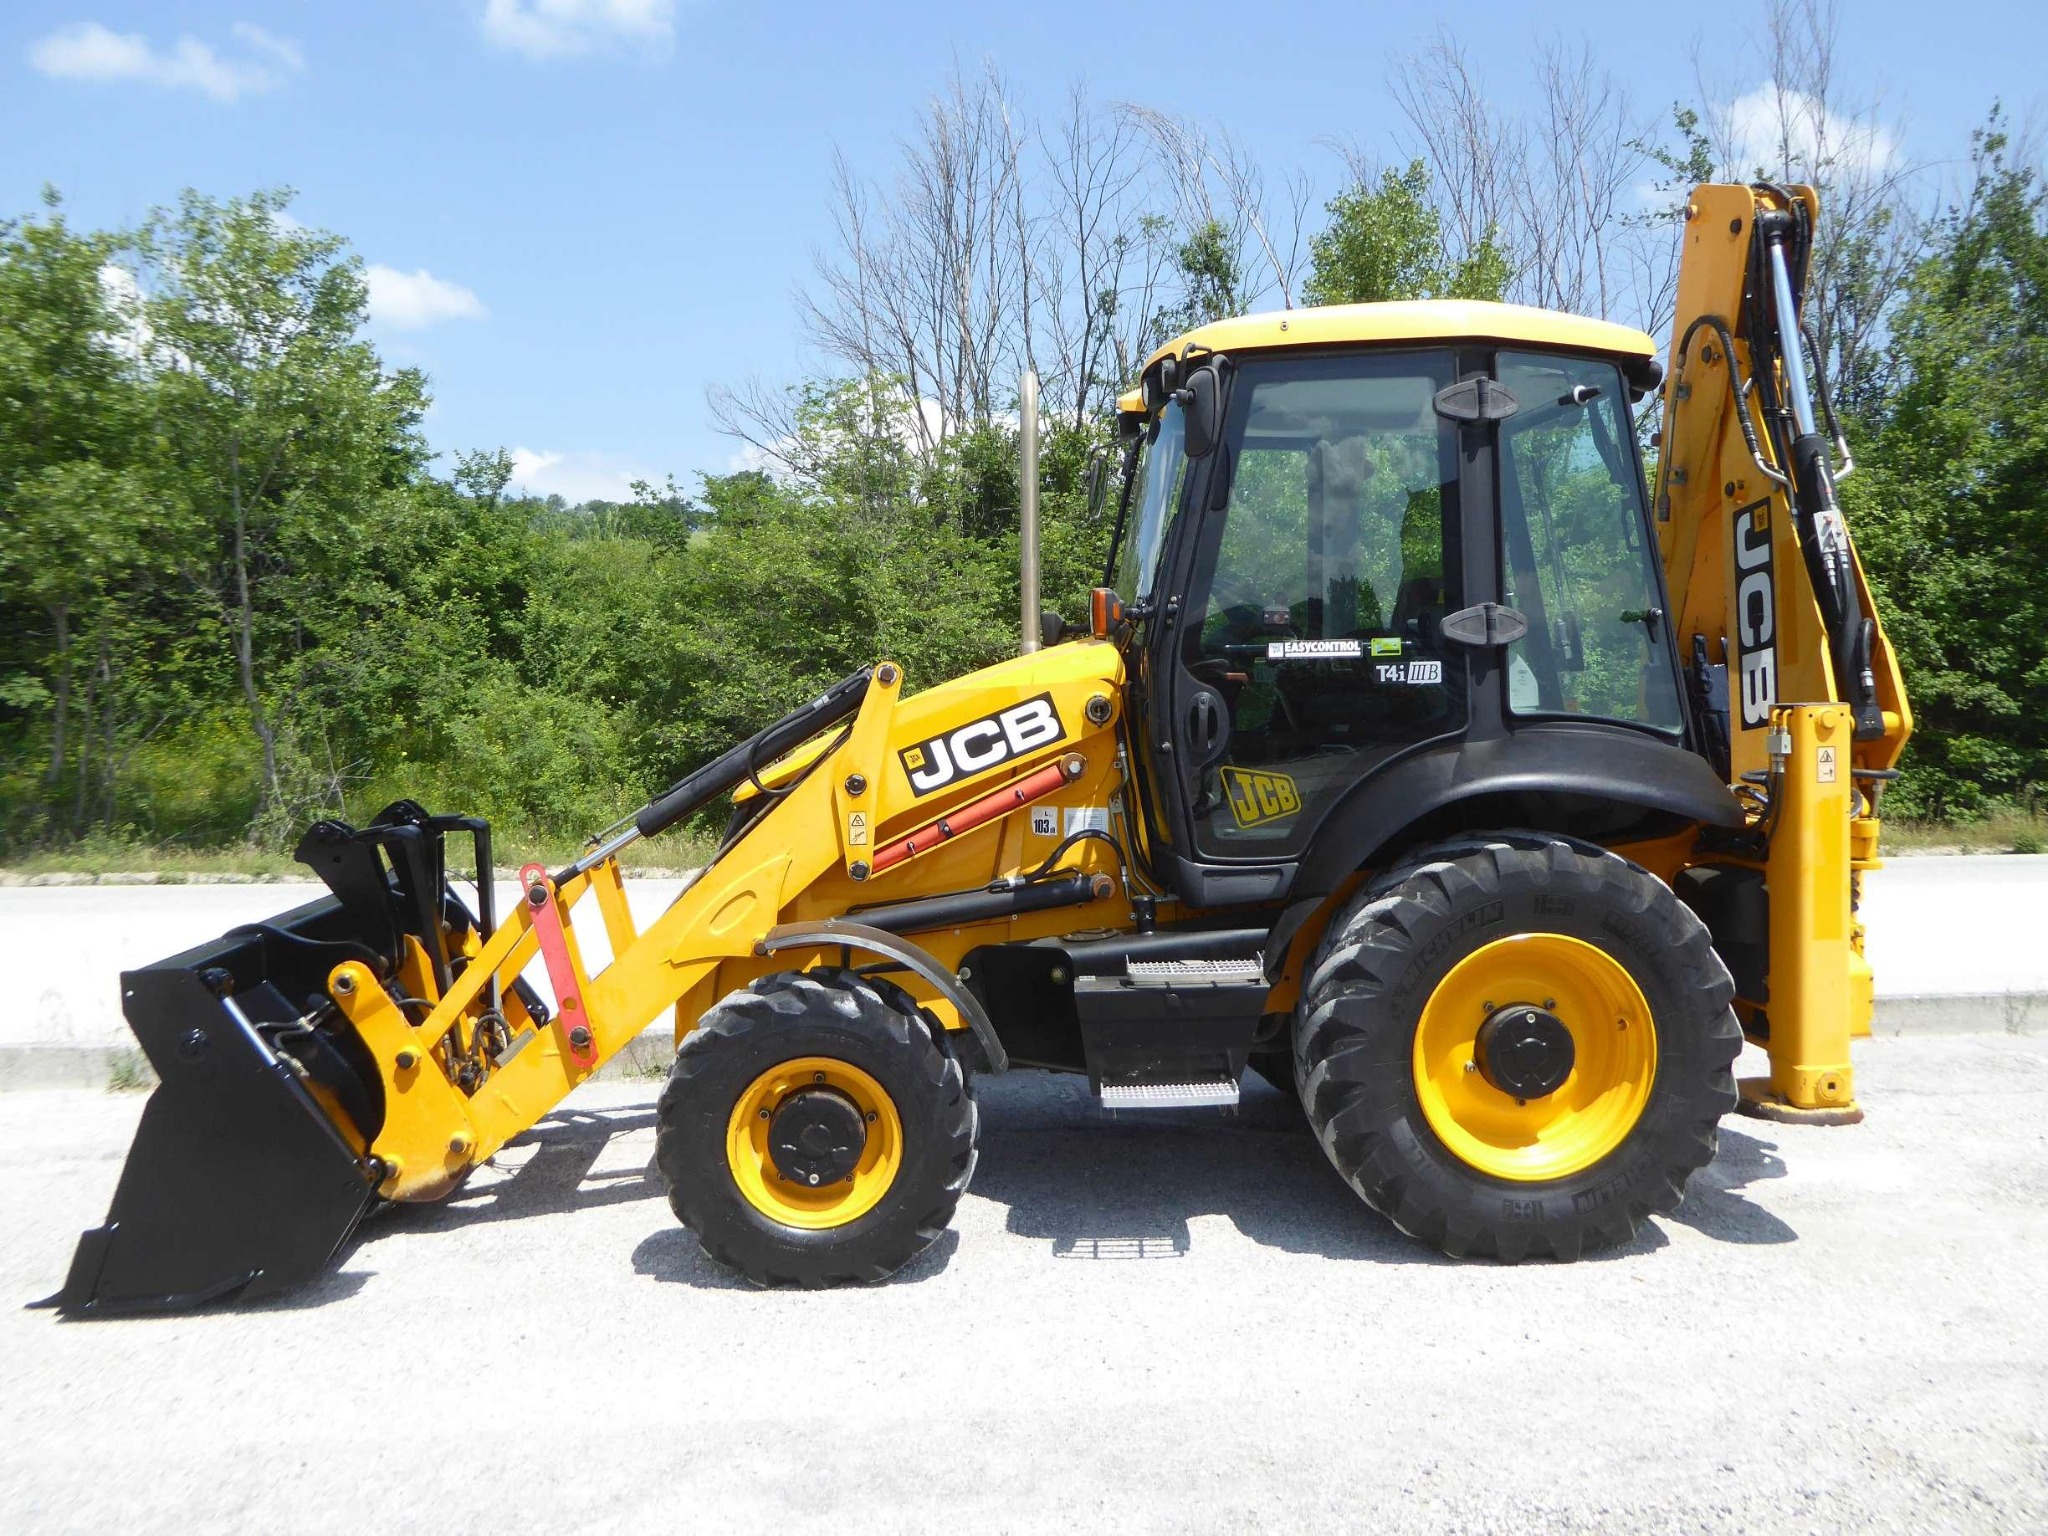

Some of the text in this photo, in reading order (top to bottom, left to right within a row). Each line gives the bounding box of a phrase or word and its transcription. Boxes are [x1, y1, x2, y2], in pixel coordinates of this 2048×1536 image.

[1737, 511, 1775, 725] JCB
[1285, 641, 1361, 653] EASYCONTROL
[1376, 664, 1406, 682] T4i
[911, 699, 1059, 790] JCB
[1235, 773, 1296, 823] JCB
[1034, 819, 1049, 833] 103
